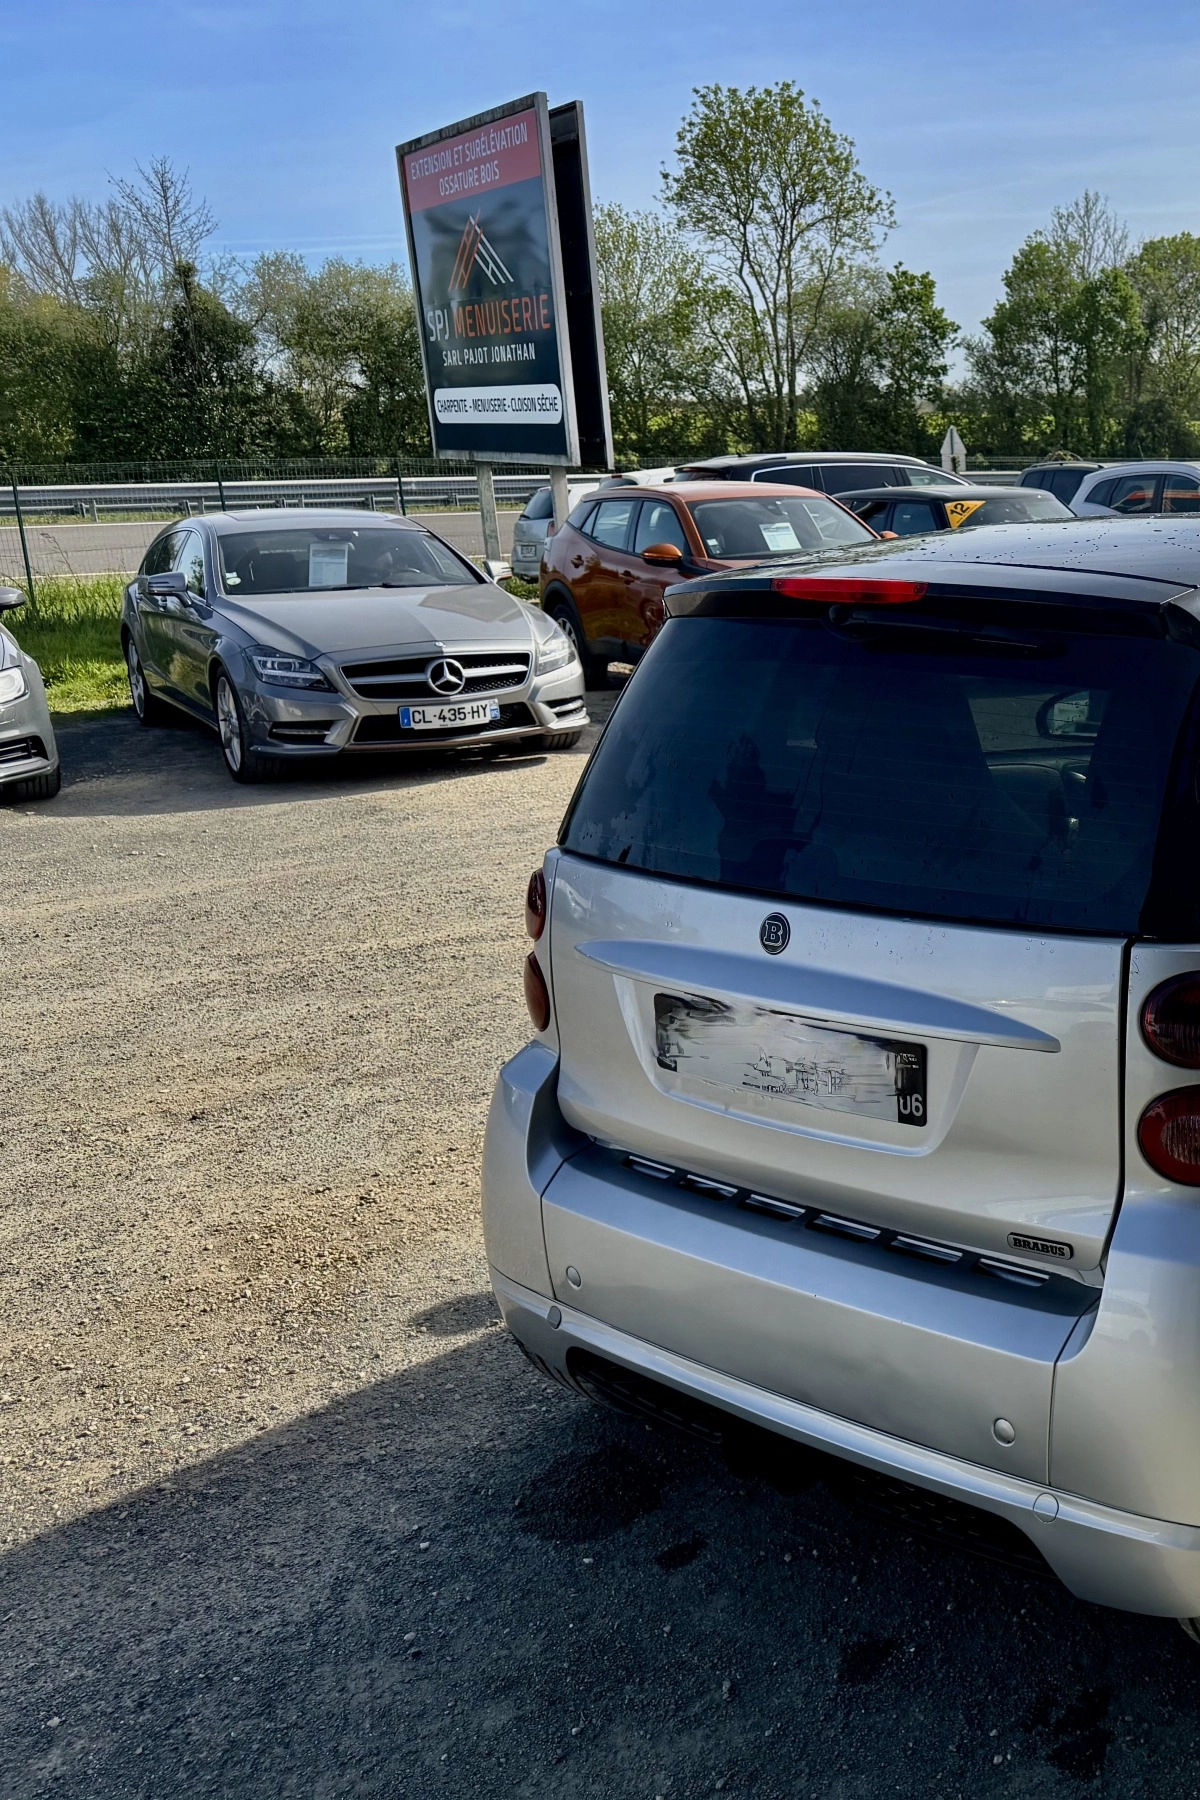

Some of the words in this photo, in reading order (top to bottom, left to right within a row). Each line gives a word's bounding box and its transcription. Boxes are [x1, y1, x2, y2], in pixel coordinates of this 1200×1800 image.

[410, 149, 452, 180] EXTENSION
[453, 144, 464, 166] ET
[465, 121, 528, 162] SURÉLÉVATION
[439, 167, 479, 196] OSSATURE
[480, 160, 500, 184] BOIS
[426, 308, 450, 342] SPJ
[452, 294, 551, 339] MENUISERIE
[442, 349, 463, 367] SARL
[464, 346, 488, 365] PAJOT
[491, 342, 536, 363] JONATHAN
[437, 399, 468, 413] CHARPENTE
[472, 398, 507, 413] MENUISERIE
[510, 397, 537, 412] CLOISON
[950, 502, 971, 517] 12
[411, 703, 488, 724] CL-435-HY
[763, 920, 783, 947] B
[1012, 1237, 1066, 1257] BRABUS
